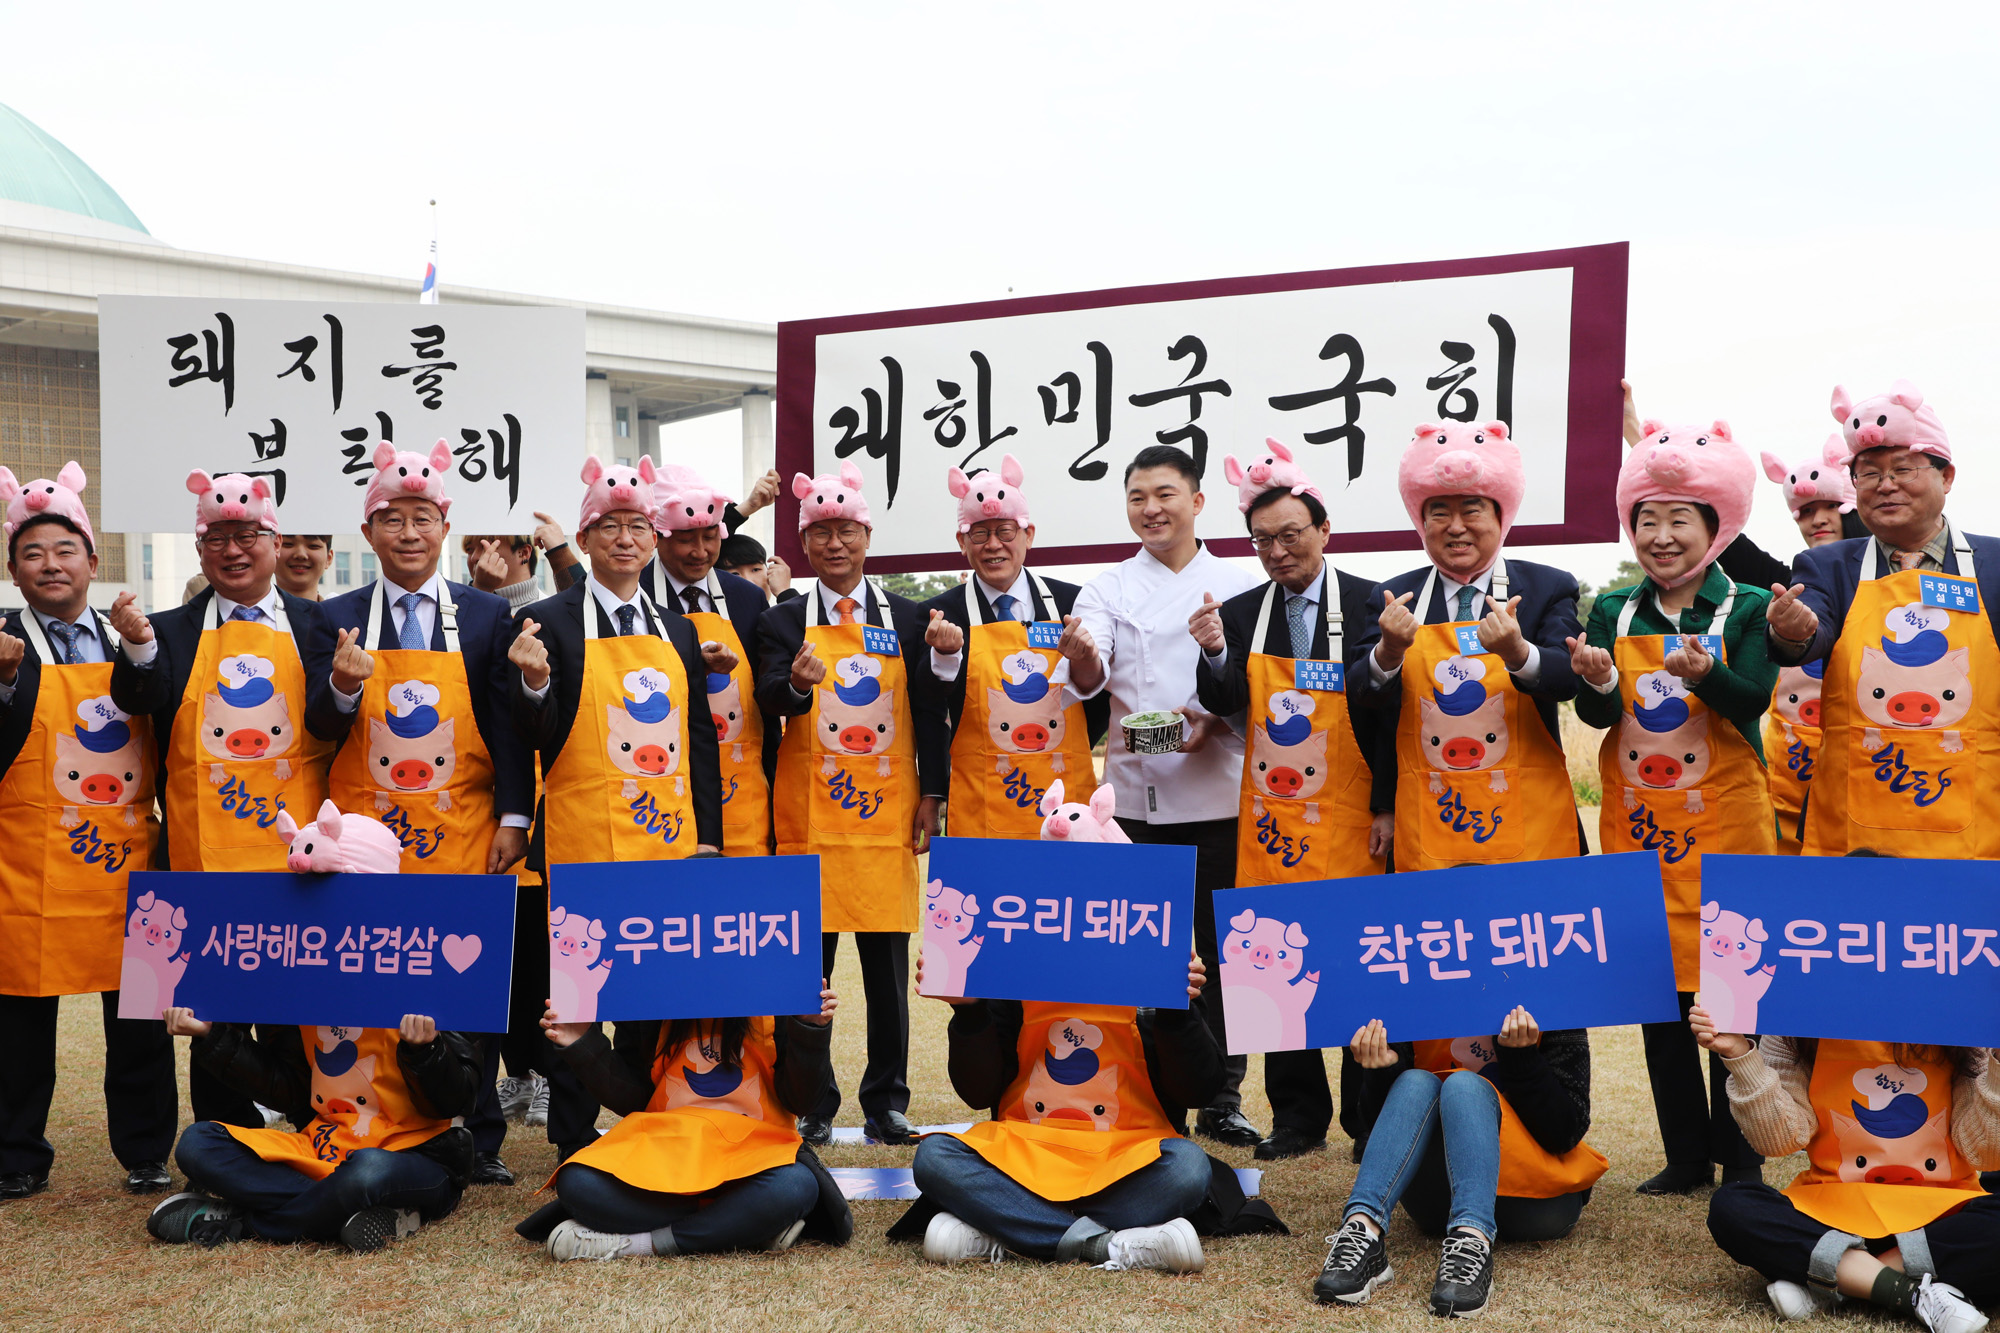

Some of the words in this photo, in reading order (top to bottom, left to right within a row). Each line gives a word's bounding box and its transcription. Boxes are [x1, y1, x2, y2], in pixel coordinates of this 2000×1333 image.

[167, 312, 457, 415] 돼지를
[1924, 580, 1975, 597] 국회의원
[866, 630, 896, 643] 국회의원
[1035, 634, 1060, 645] 이재명
[1301, 670, 1339, 682] 국회의원
[1305, 662, 1334, 672] 당대표
[1305, 680, 1334, 691] 이해찬
[829, 769, 883, 819] 한돈
[1872, 742, 1951, 806] 한돈
[218, 775, 286, 828] 한돈
[631, 791, 682, 843] 한돈
[1437, 787, 1503, 843] 한돈
[68, 820, 131, 873] 한돈
[1257, 812, 1309, 867] 한돈
[1629, 804, 1695, 864] 한돈
[614, 914, 701, 966] 우리
[713, 910, 800, 957] 돼지
[987, 895, 1070, 944] 우리
[1083, 899, 1171, 947] 돼지
[1359, 918, 1474, 984] 착한
[1489, 906, 1608, 968] 돼지
[1779, 919, 1885, 973] 우리
[202, 922, 329, 971] 사랑해요
[334, 926, 439, 976] 삼겹살
